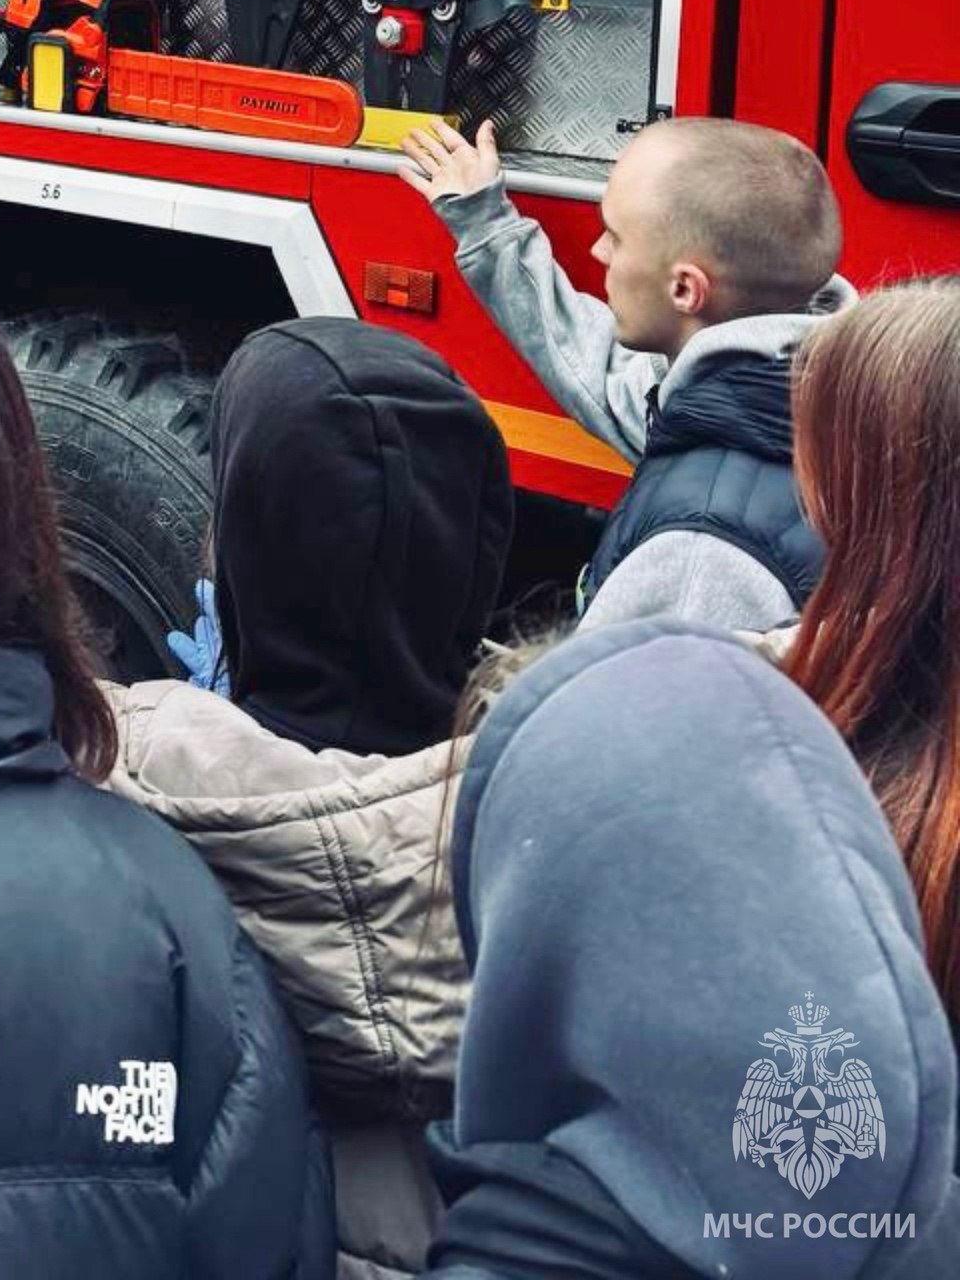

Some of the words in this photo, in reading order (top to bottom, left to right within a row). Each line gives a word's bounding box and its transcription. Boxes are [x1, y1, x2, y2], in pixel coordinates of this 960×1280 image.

[41, 183, 62, 200] 5.6
[119, 1061, 173, 1089] THE
[76, 1084, 173, 1115] NORTH
[105, 1114, 173, 1145] FACE
